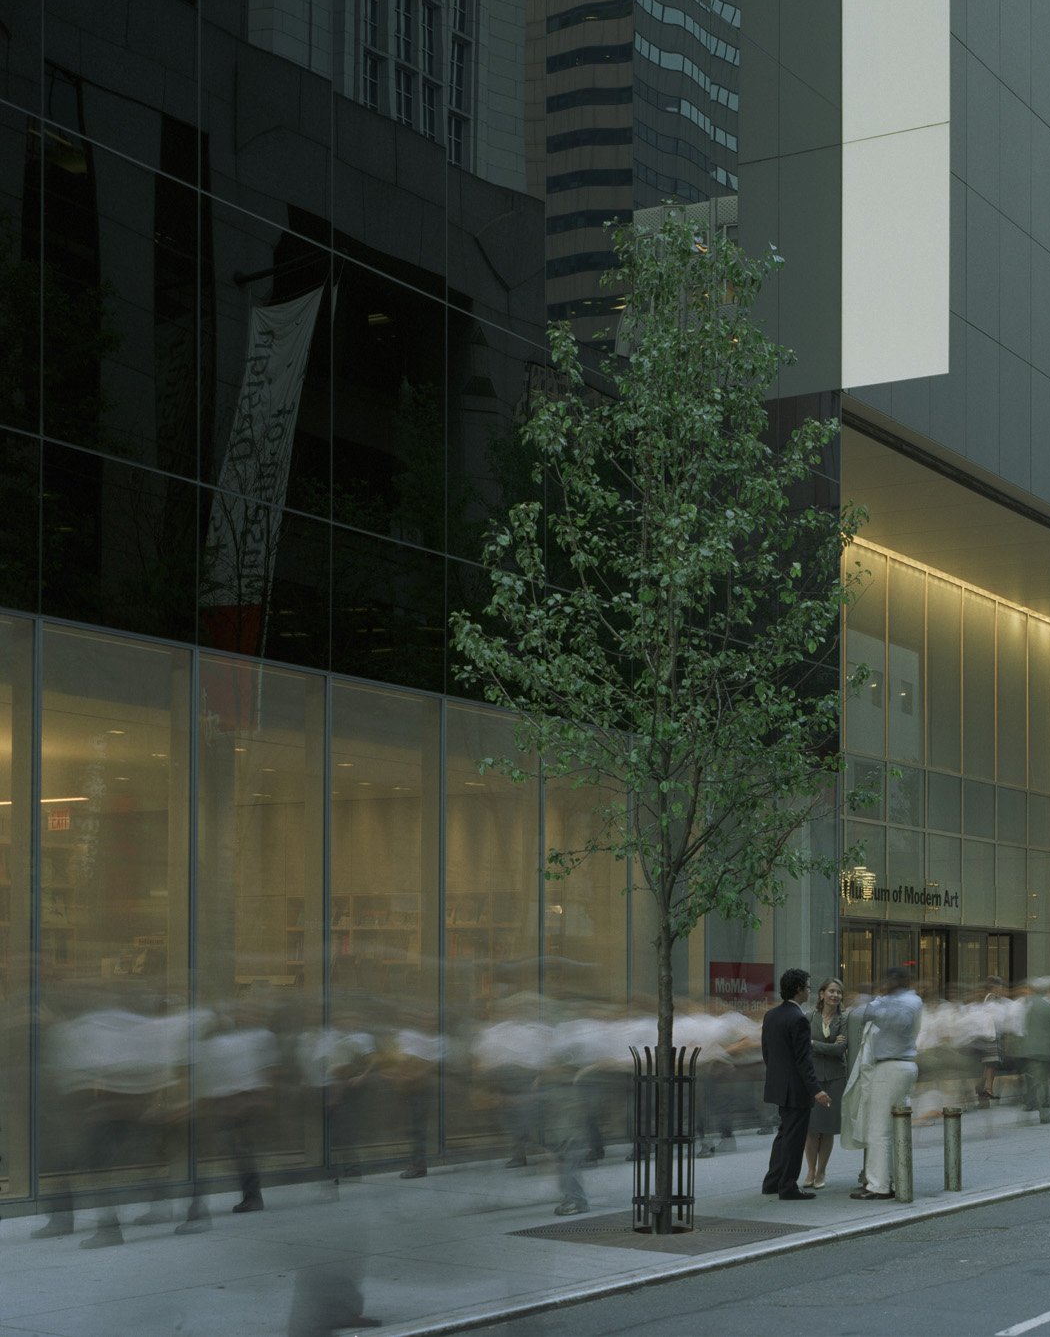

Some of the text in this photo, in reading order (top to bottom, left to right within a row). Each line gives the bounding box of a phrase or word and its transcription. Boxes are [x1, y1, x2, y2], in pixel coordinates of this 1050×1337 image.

[892, 885, 903, 903] of
[904, 886, 942, 907] Modern
[943, 889, 959, 908] Art
[714, 977, 748, 994] MoMA
[715, 996, 768, 1012] Design and
